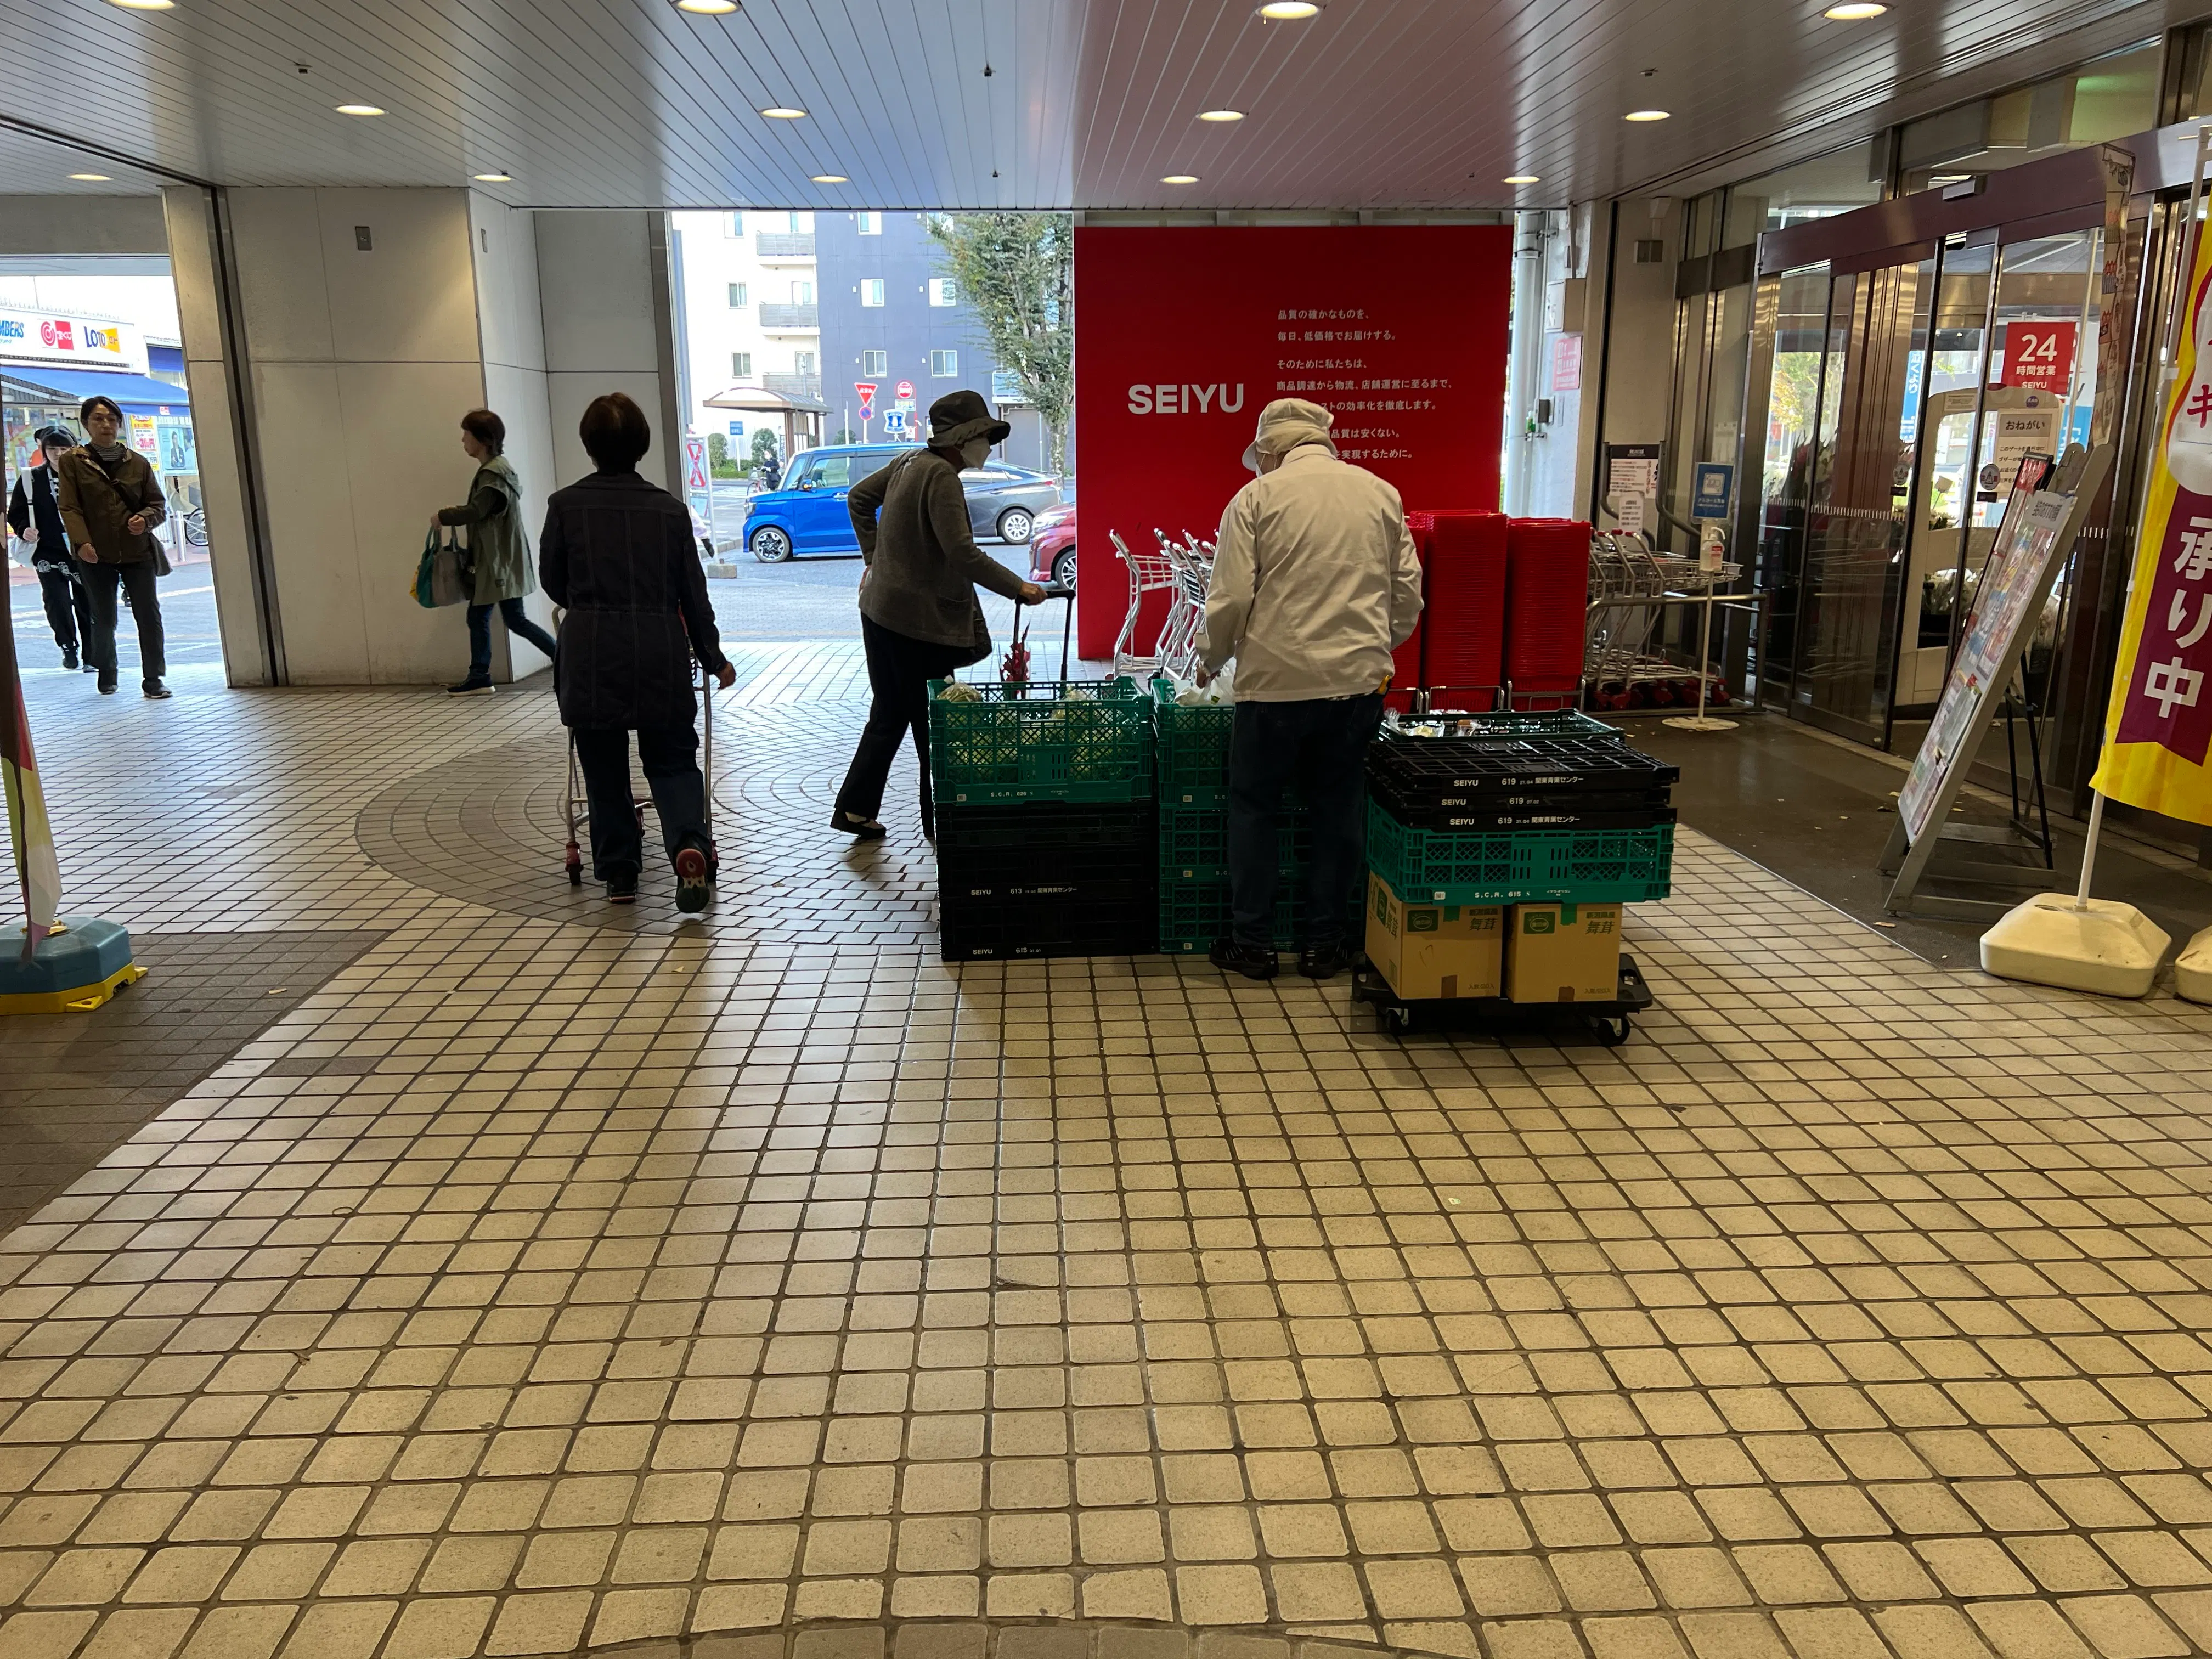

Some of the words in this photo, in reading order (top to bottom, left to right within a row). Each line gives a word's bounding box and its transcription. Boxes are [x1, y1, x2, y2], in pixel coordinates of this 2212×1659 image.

[1277, 308, 1369, 320] 品質の確かなものを、
[83, 325, 106, 348] LOTO
[1277, 330, 1396, 342] 毎日、低価格でお届けする。
[2018, 334, 2058, 362] 24
[1277, 358, 1367, 370] そのために私たちは、
[2016, 365, 2057, 376] 時間営業
[1276, 378, 1453, 391] 商品調達から物流、店舗運営に至るまで、
[1128, 383, 1244, 415] SEIYU
[2005, 420, 2046, 431] おねがい
[1327, 428, 1400, 439] 品質は安くない。
[1468, 917, 1498, 931] 舞茸
[1585, 921, 1616, 935] 舞茸
